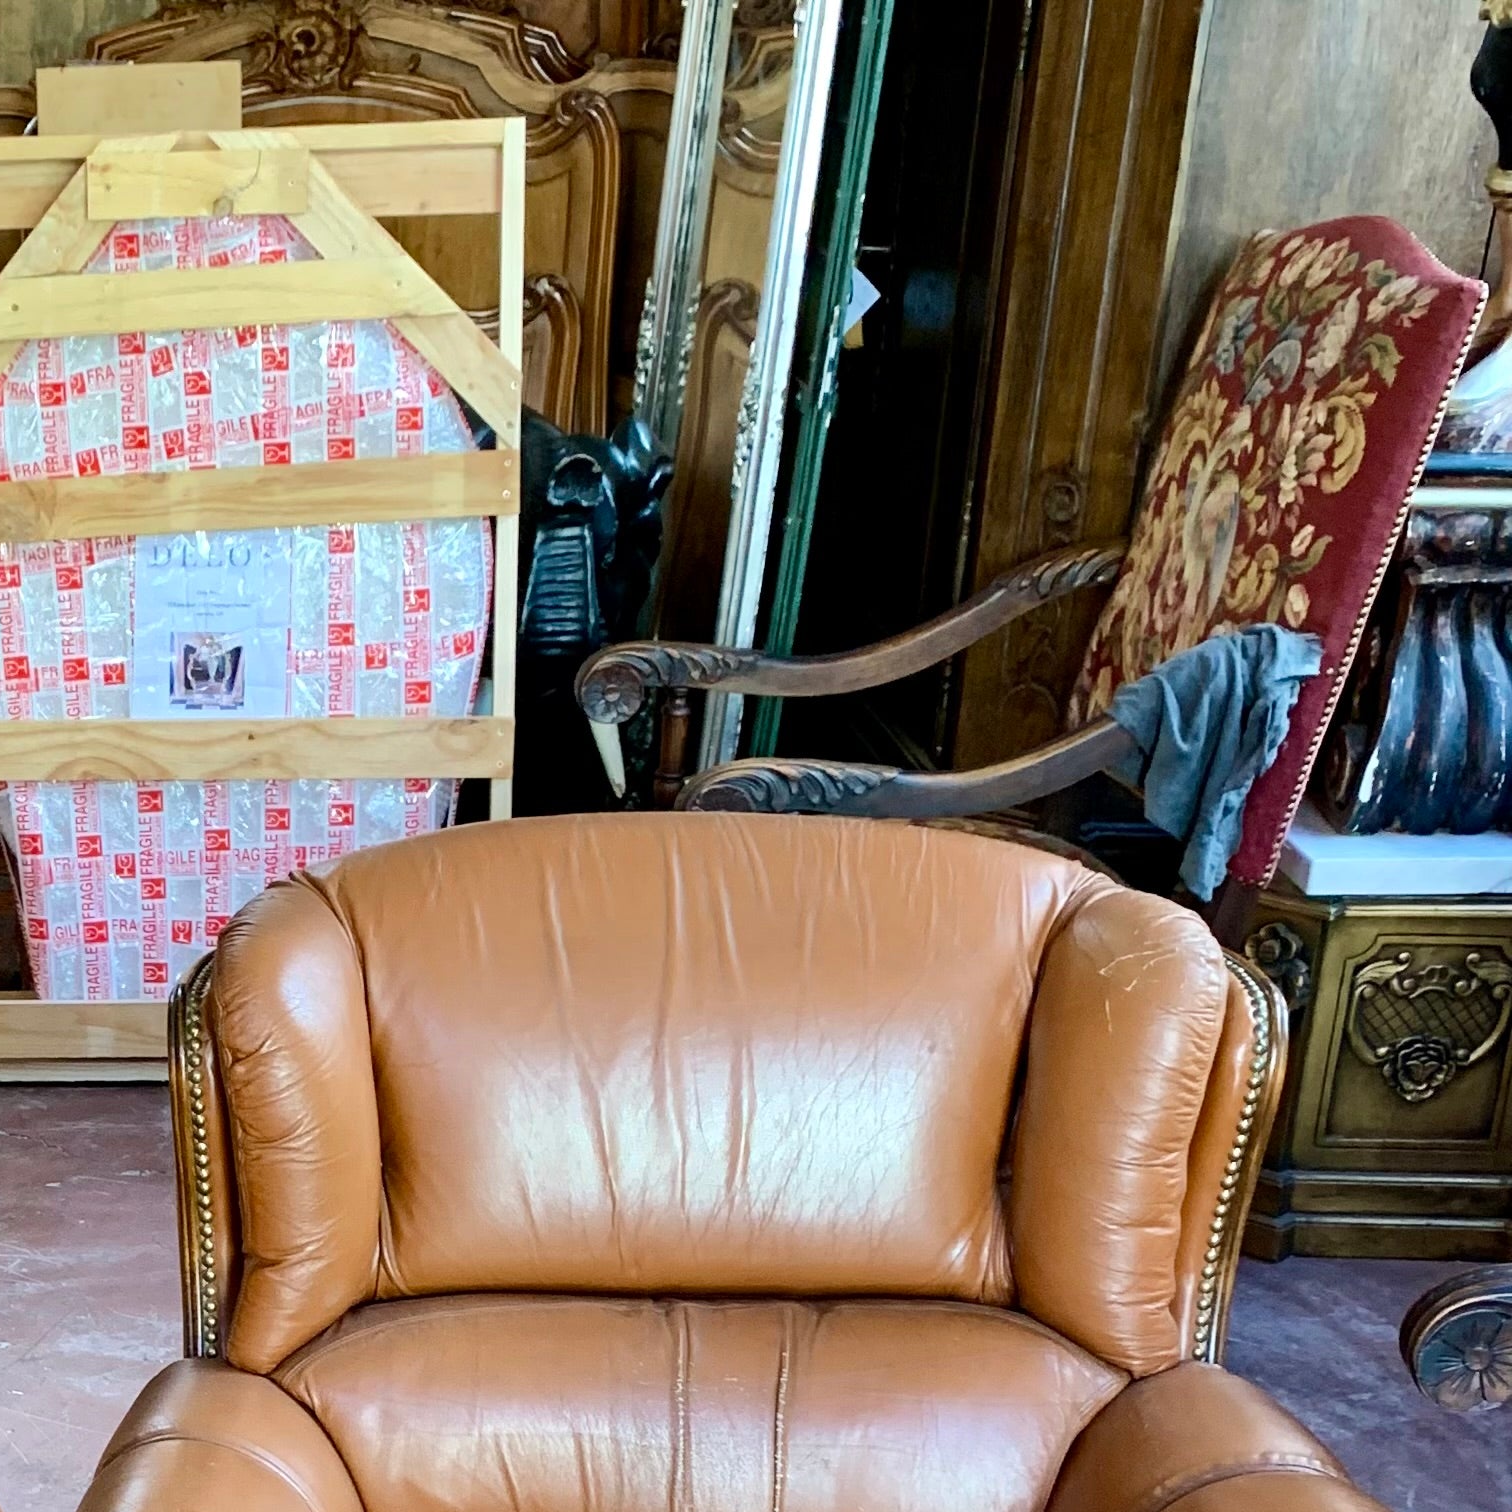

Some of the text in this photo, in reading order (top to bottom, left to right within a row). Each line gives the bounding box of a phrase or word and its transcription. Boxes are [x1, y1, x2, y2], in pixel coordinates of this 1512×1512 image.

[176, 216, 190, 270] FRAGIL
[118, 359, 136, 423] FRAGILE
[261, 375, 277, 439] FRAGILE
[185, 400, 202, 463] FRAGILE
[216, 416, 248, 437] GILE
[404, 615, 420, 678] FRAGILE
[328, 650, 344, 711] FRAGILE
[15, 780, 31, 832] FRAGIL
[72, 780, 89, 832] FRAGIL
[138, 816, 155, 875] FRAGILE
[167, 850, 196, 865] GILE
[21, 858, 37, 915] FRAGILE
[78, 860, 96, 920] FRAGILE
[204, 854, 221, 912] FRAGILE
[140, 903, 158, 960] FRAGILE
